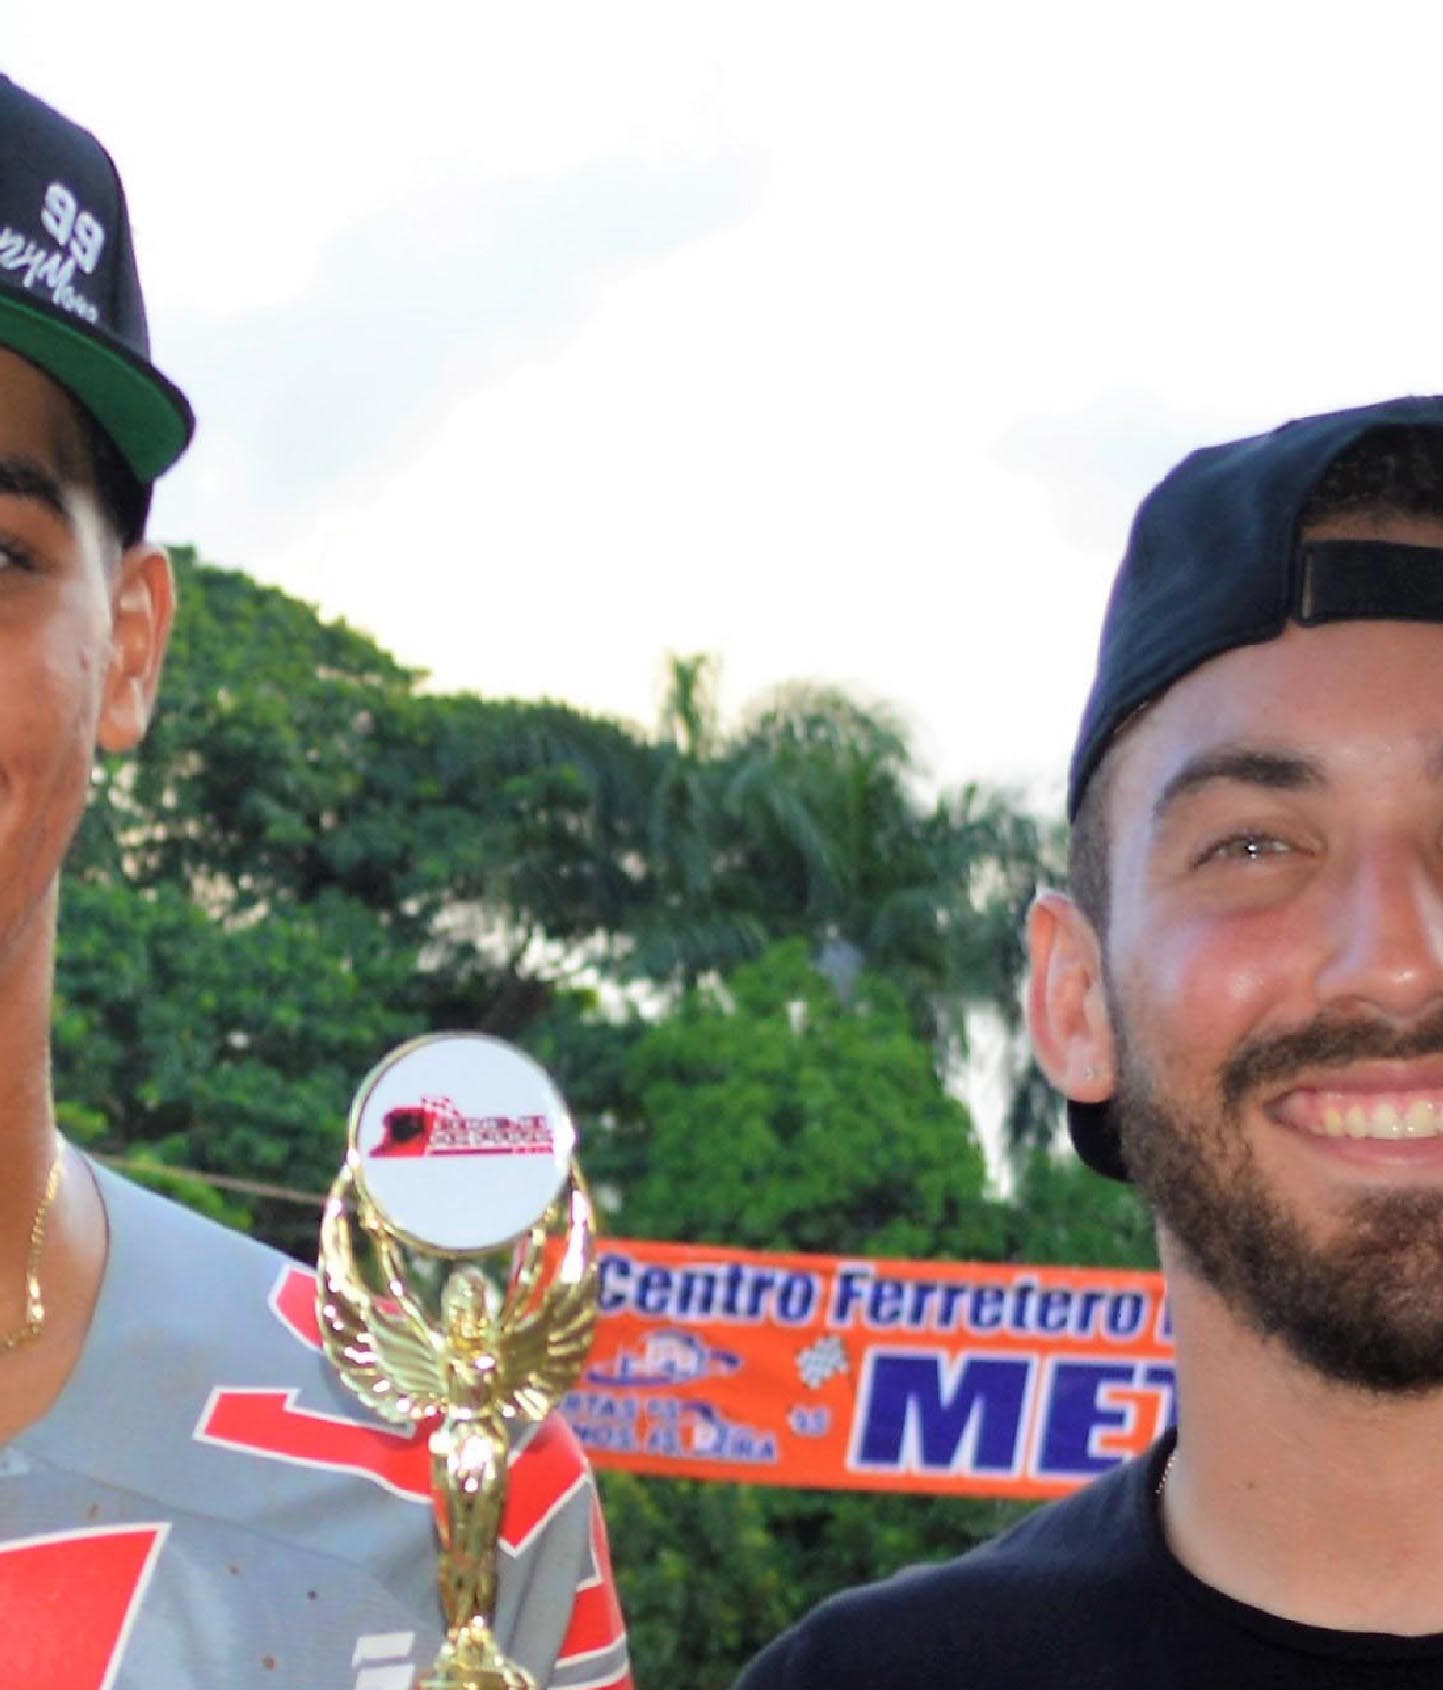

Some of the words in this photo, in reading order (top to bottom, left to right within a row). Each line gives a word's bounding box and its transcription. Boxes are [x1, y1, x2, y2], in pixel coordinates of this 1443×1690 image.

[40, 181, 105, 275] 99
[596, 1252, 820, 1326] Centro
[826, 1259, 1150, 1339] Ferretero
